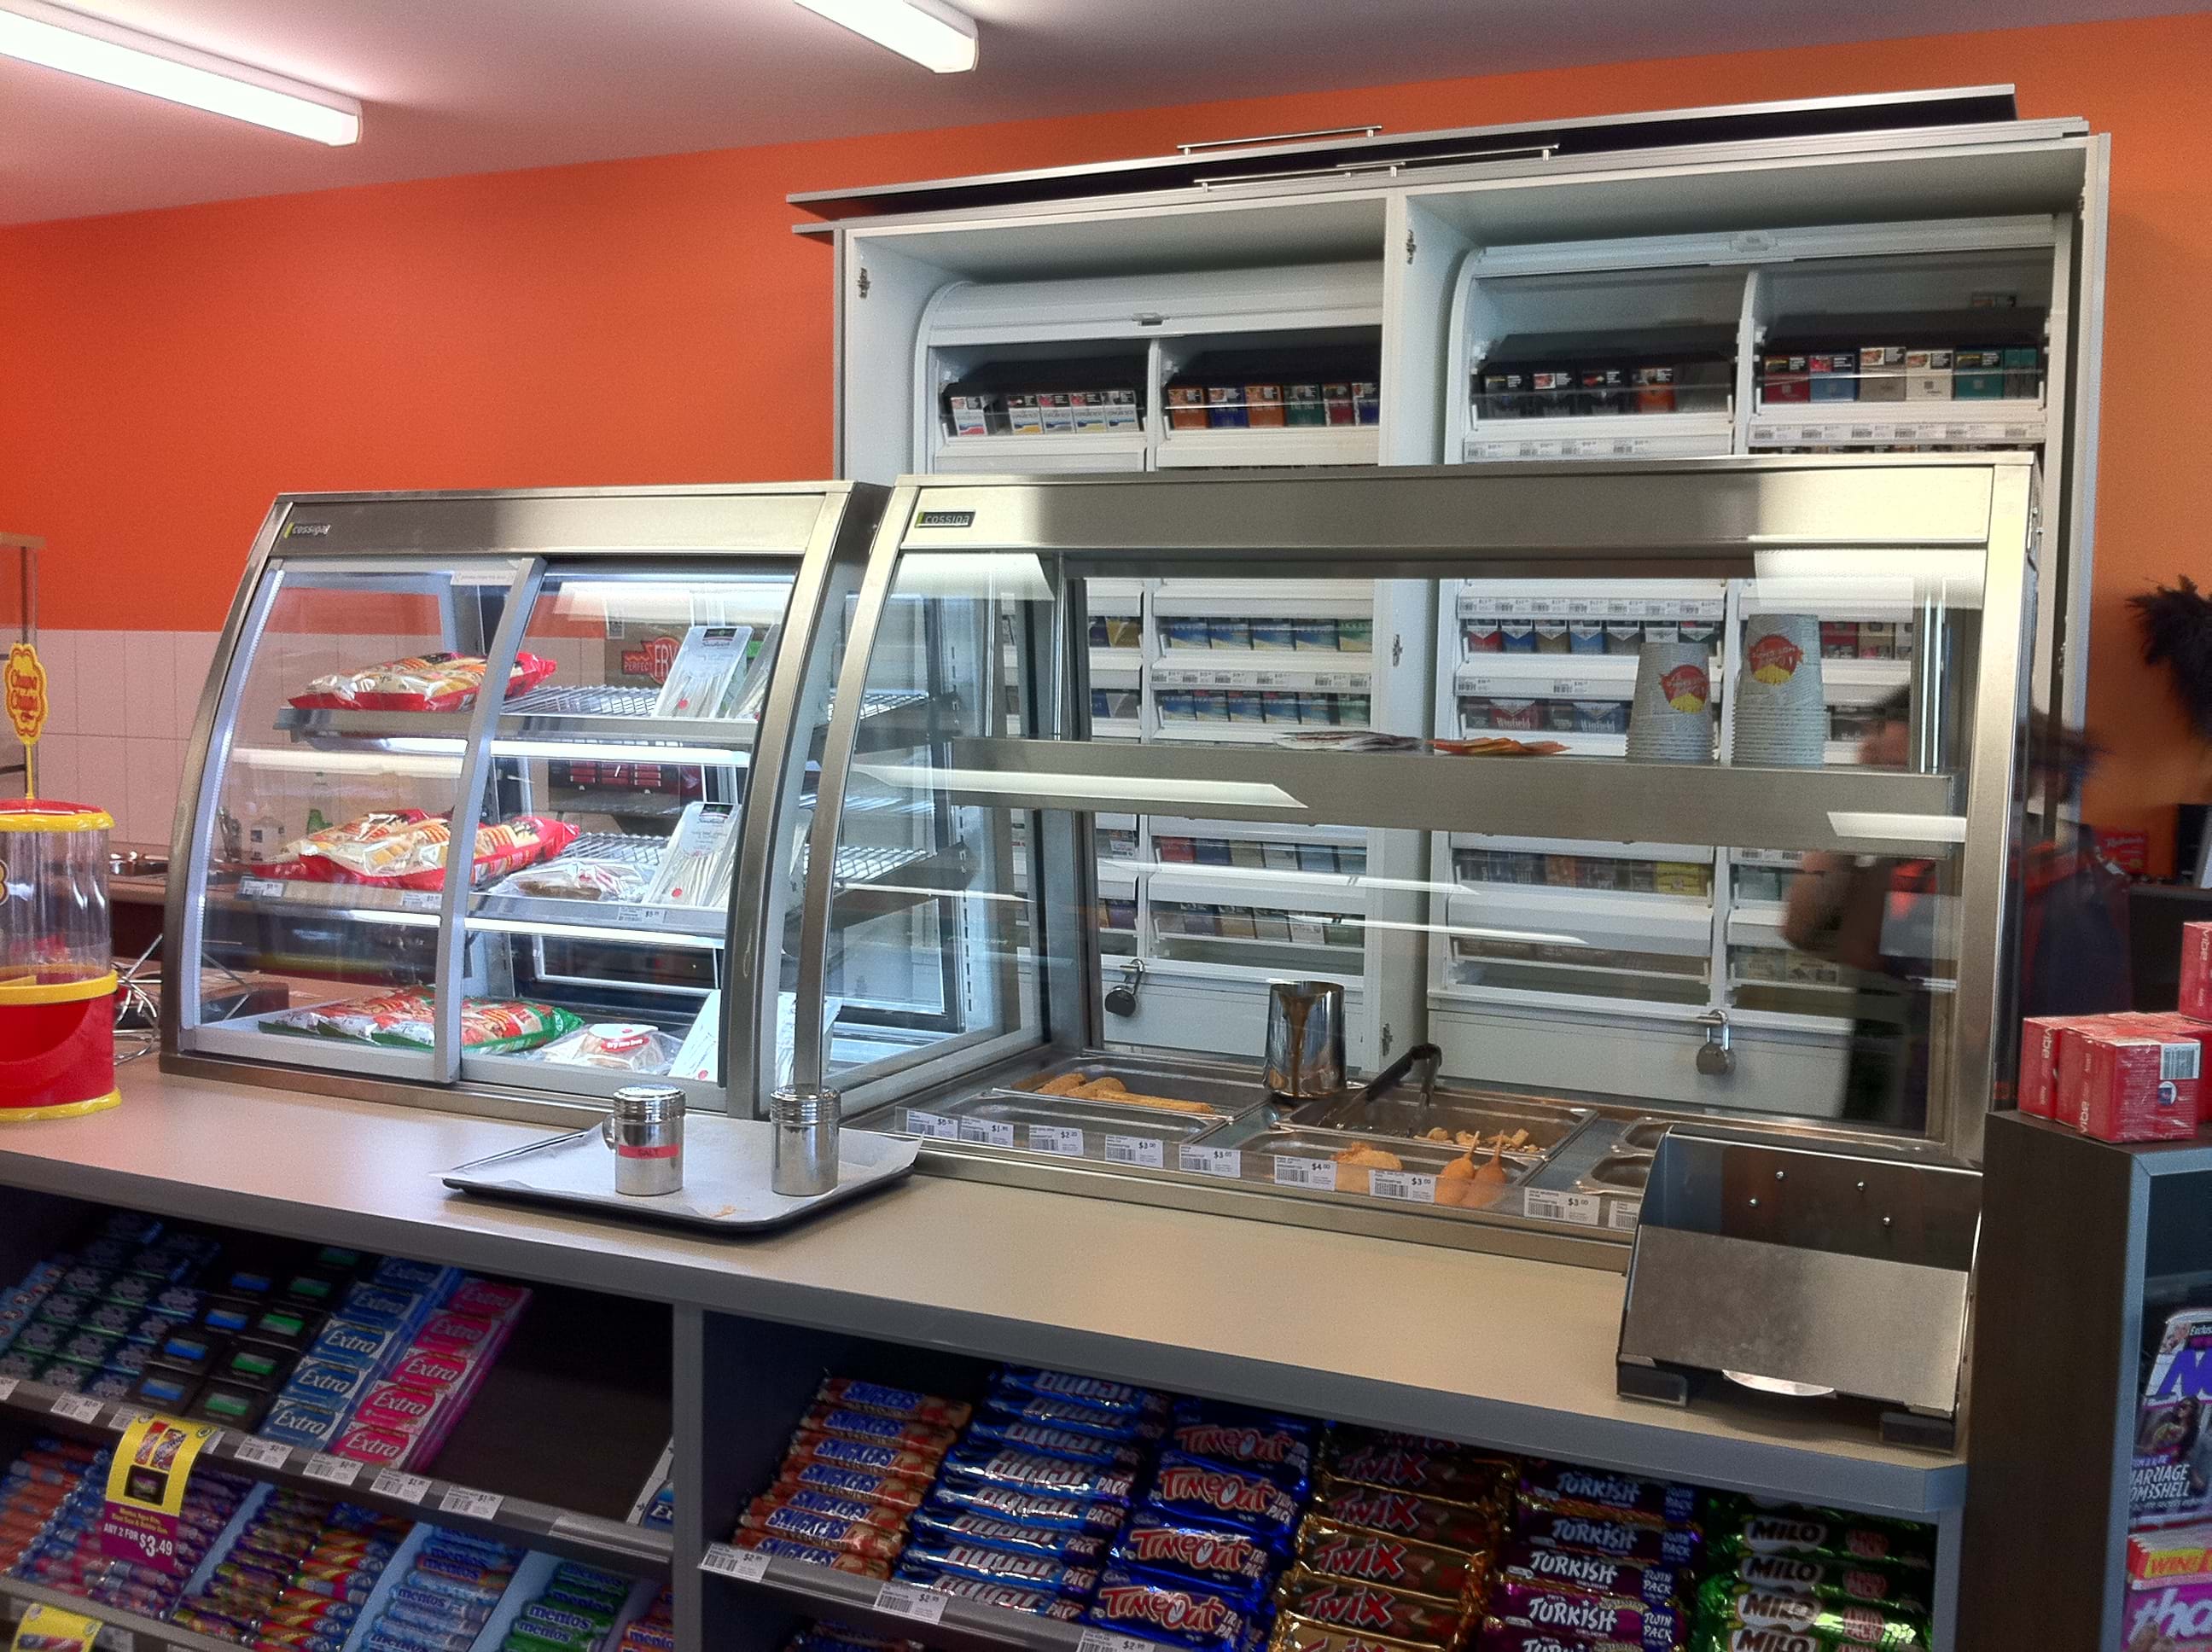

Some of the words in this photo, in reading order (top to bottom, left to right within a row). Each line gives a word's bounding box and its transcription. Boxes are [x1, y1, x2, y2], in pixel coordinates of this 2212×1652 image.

[324, 1329, 378, 1356] Extra
[299, 1368, 352, 1394] Extra
[404, 1356, 460, 1382] Extra
[372, 1388, 428, 1416] Extra
[274, 1409, 328, 1437] Extra
[346, 1431, 403, 1460] Extra
[1095, 1477, 1131, 1496] PACK
[1085, 1507, 1121, 1528] PACK
[1329, 1488, 1422, 1532] Twix
[119, 1527, 125, 1537] 2
[125, 1528, 138, 1541] FOR
[139, 1533, 173, 1557] $3.49
[1753, 1521, 1821, 1542] MILO
[1314, 1537, 1407, 1579] Twix
[1529, 1550, 1619, 1585] TURKISH
[1748, 1557, 1817, 1581] MILO
[1643, 1580, 1674, 1595] PACK
[1644, 1569, 1674, 1582] TWIN
[398, 1588, 447, 1607] mentos
[555, 1591, 615, 1614] mentos
[1301, 1585, 1395, 1628] Twix
[531, 1605, 591, 1630] mentos
[1528, 1597, 1618, 1632] TURKISH
[1644, 1611, 1673, 1626] TWIN
[518, 1620, 572, 1643] mentos
[629, 1629, 674, 1649] mento
[1644, 1625, 1674, 1639] PACK
[1737, 1630, 1811, 1652] MILO
